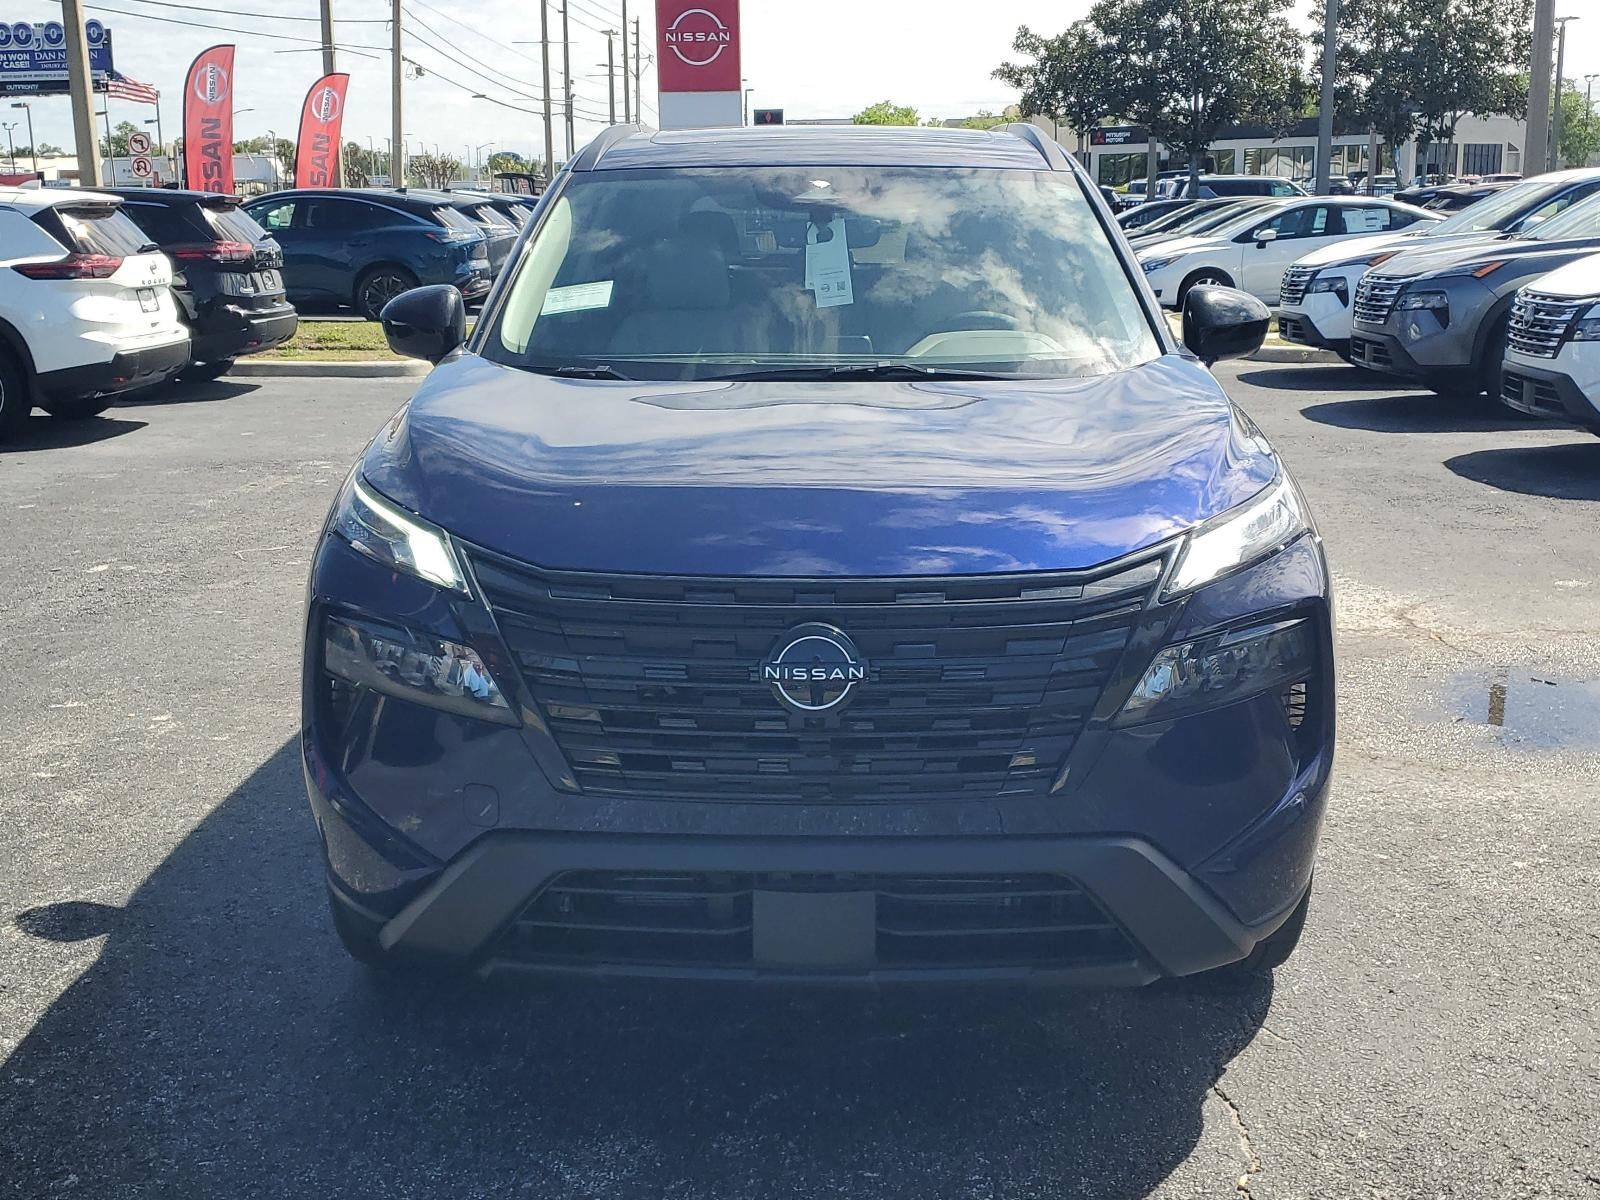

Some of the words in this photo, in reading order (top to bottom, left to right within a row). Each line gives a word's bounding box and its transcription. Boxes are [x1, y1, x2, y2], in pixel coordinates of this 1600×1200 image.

[665, 32, 730, 42] NISSAN
[34, 51, 56, 60] DAN
[322, 89, 332, 121] NISSAN
[765, 666, 864, 680] NISSAN
